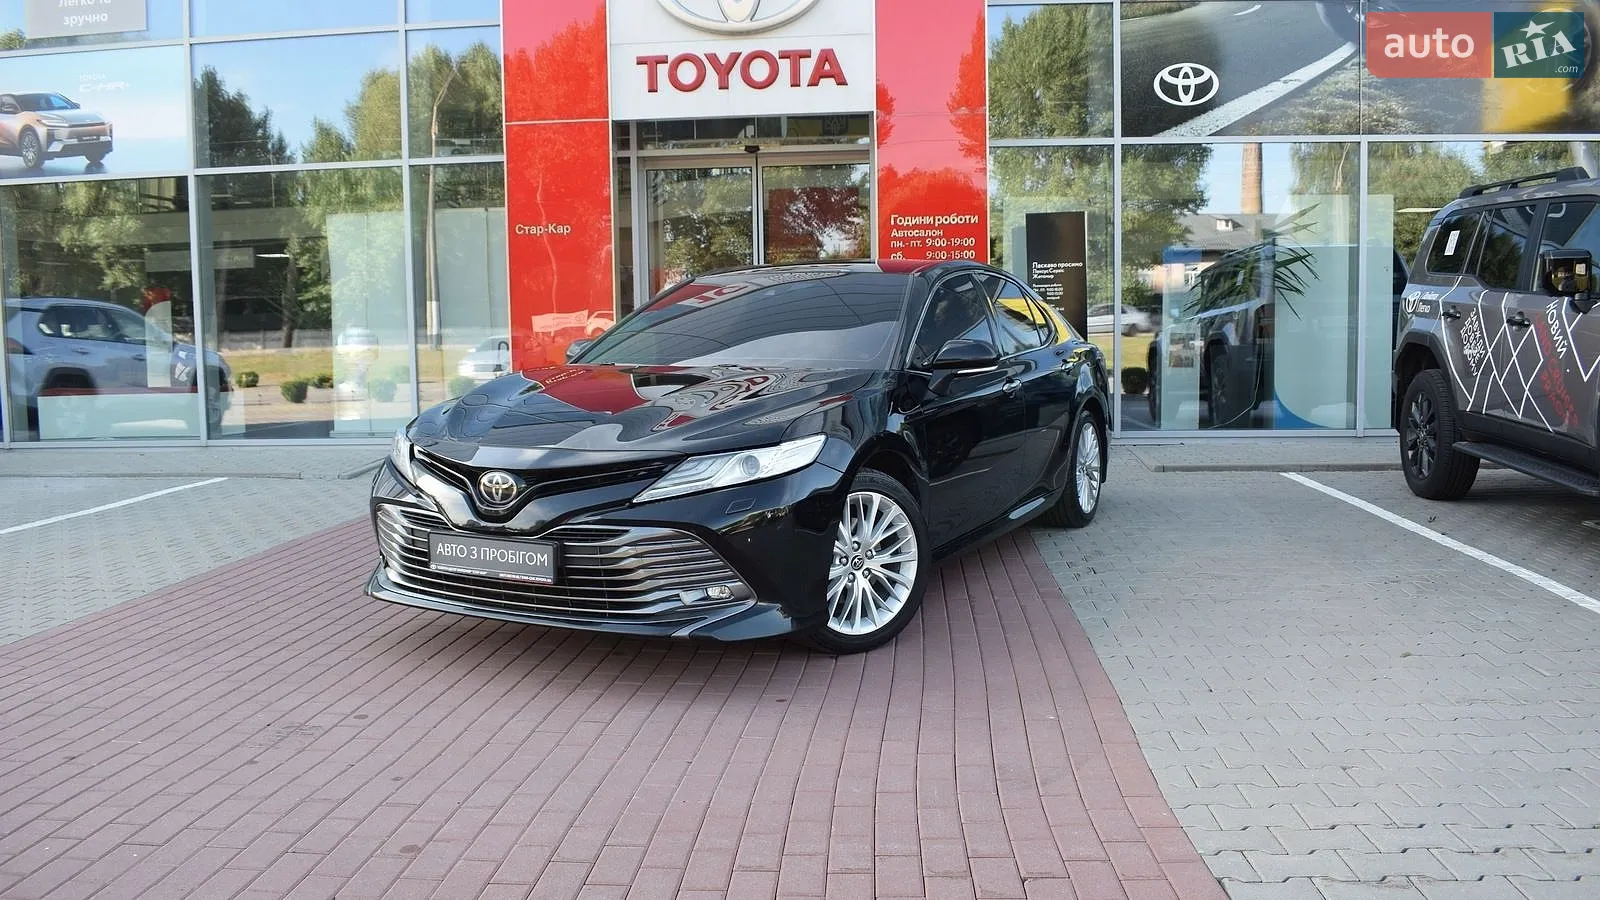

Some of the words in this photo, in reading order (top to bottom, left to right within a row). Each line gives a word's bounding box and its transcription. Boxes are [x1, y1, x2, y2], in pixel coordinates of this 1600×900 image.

[63, 13, 108, 27] зручно
[636, 48, 848, 93] TOYOTA
[890, 214, 934, 226] Години
[935, 213, 979, 227] роботи
[515, 223, 571, 236] Стар-Кар
[890, 228, 943, 238] Автосалон
[1545, 300, 1568, 360] НОВИЙ
[436, 542, 468, 559] АВТО
[481, 547, 548, 567] ПРОБІГОМ
